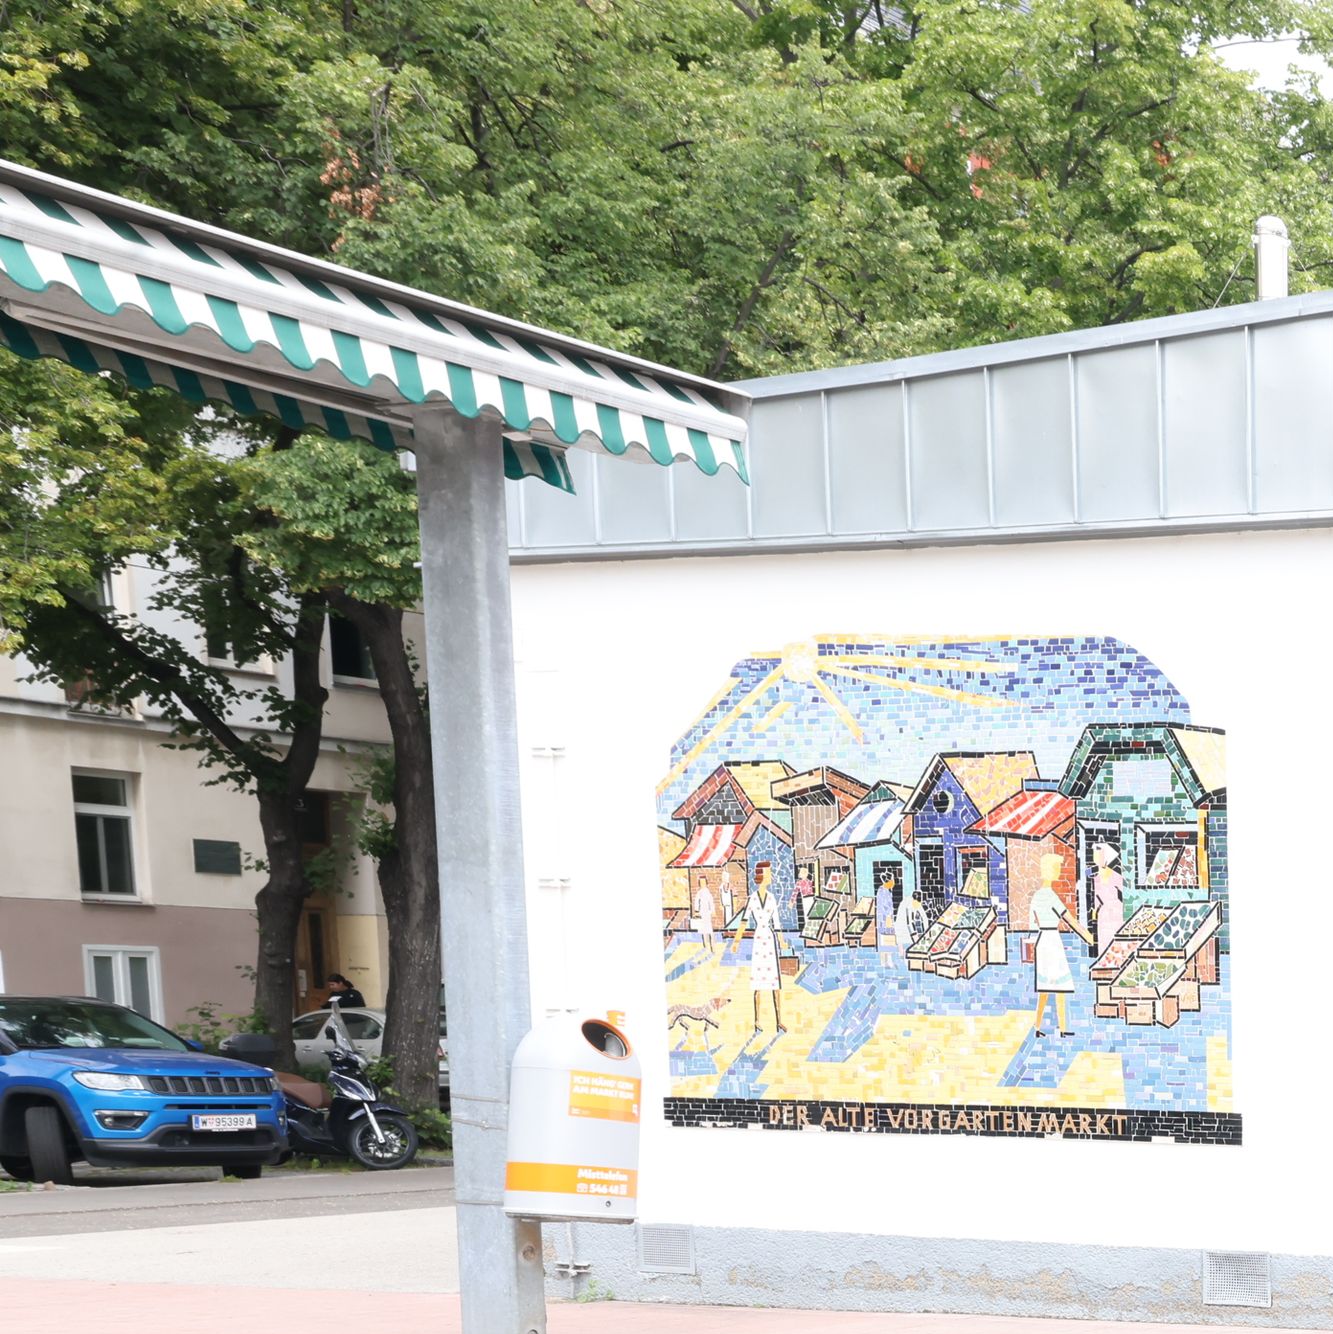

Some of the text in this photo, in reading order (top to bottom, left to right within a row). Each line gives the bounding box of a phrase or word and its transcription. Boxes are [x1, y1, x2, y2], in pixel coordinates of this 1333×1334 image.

[215, 1116, 245, 1127] 95399
[768, 1104, 1128, 1136] DER ALTE VORGARTENMARKT
